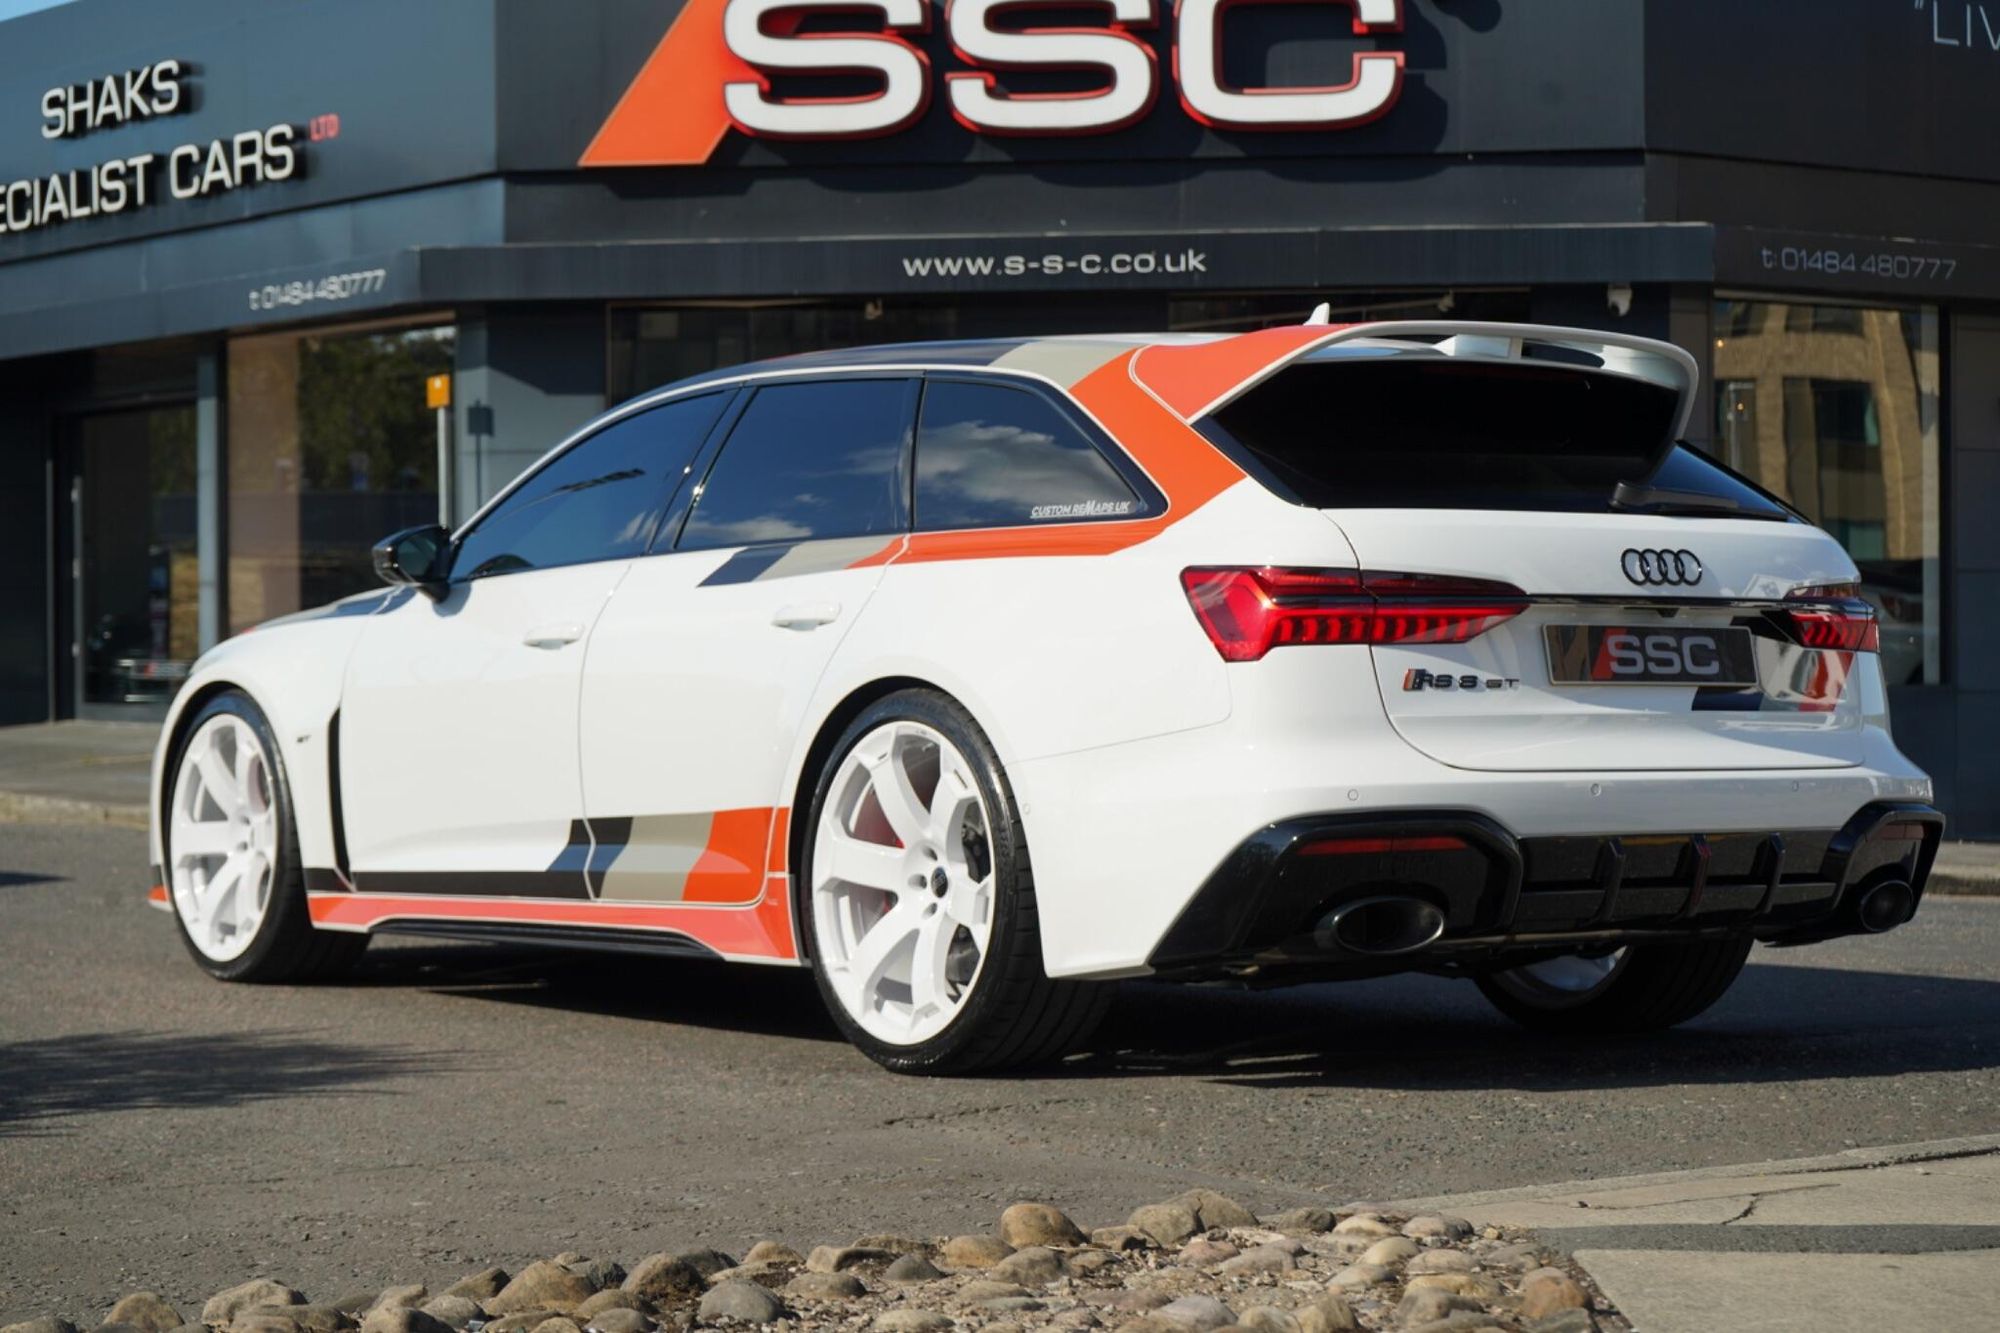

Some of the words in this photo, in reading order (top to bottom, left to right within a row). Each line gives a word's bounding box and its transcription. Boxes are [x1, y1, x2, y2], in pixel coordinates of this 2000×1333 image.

[724, 0, 1403, 137] SSC
[41, 59, 180, 139] SHAKS
[169, 124, 294, 199] CARS
[309, 113, 340, 142] LTD
[902, 249, 1207, 277] www.s-s-c.co.uk
[1860, 254, 1957, 280] 480777
[1030, 504, 1073, 518] CUSTOM
[1115, 501, 1131, 514] UK
[1608, 634, 1720, 675] SSC
